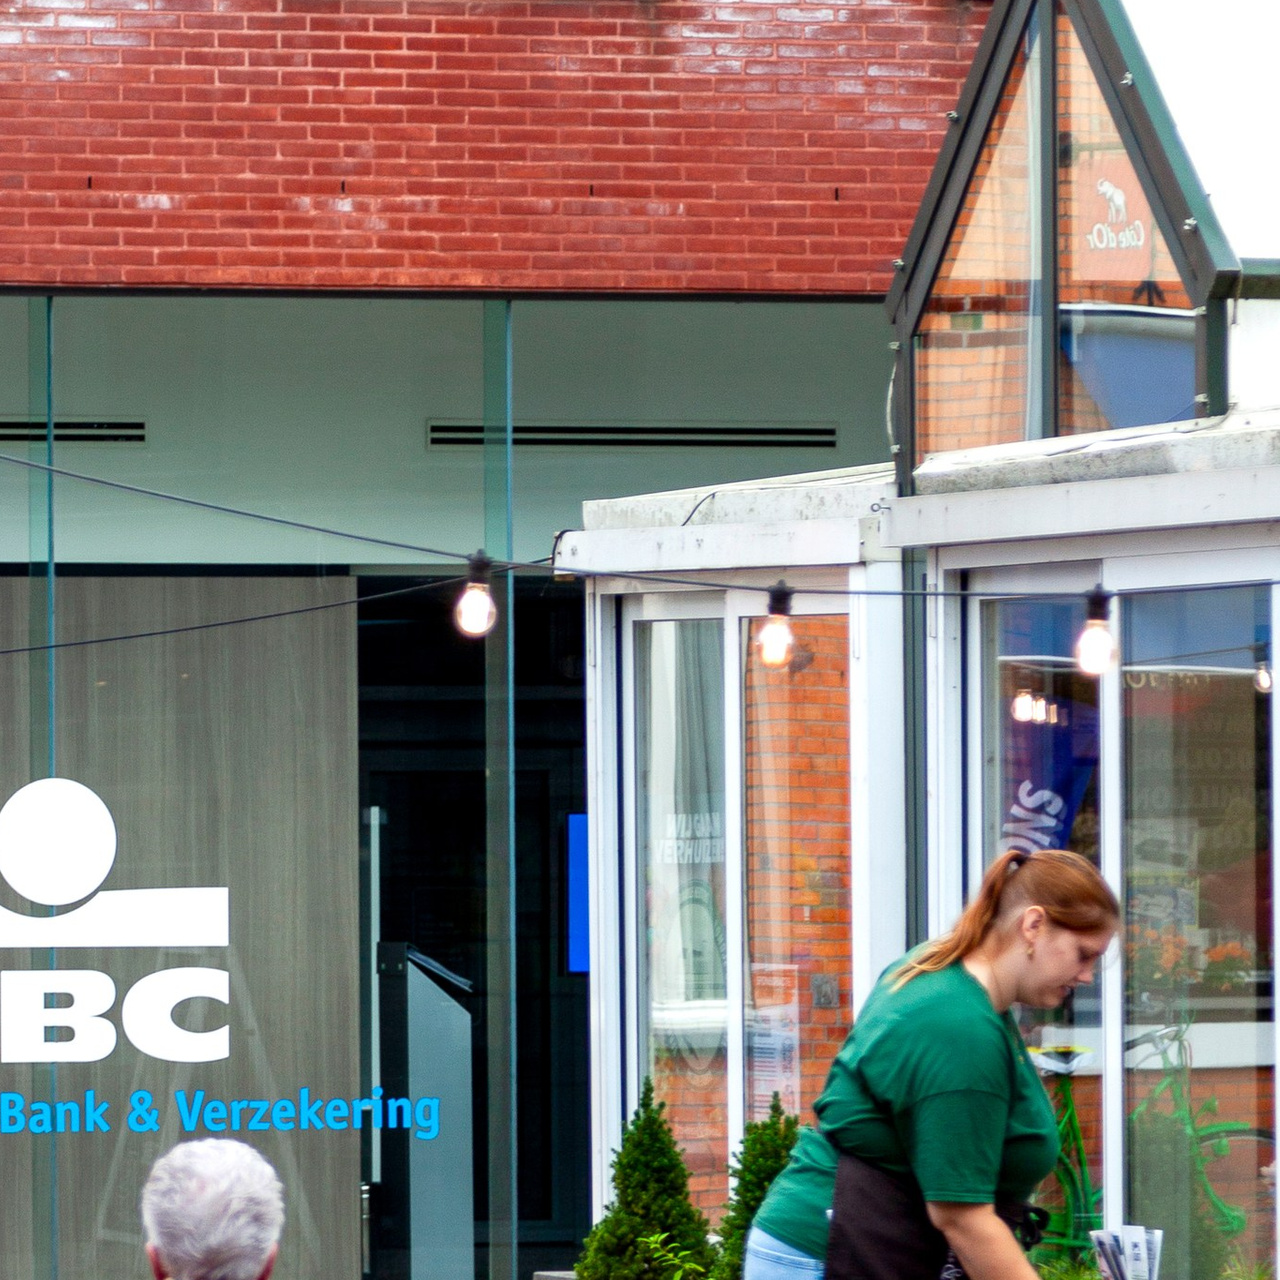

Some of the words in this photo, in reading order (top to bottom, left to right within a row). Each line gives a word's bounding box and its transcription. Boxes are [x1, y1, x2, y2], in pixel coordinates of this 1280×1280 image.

[0, 1089, 111, 1135] Bank
[126, 1090, 160, 1133] &
[174, 1085, 441, 1141] Verzekering
